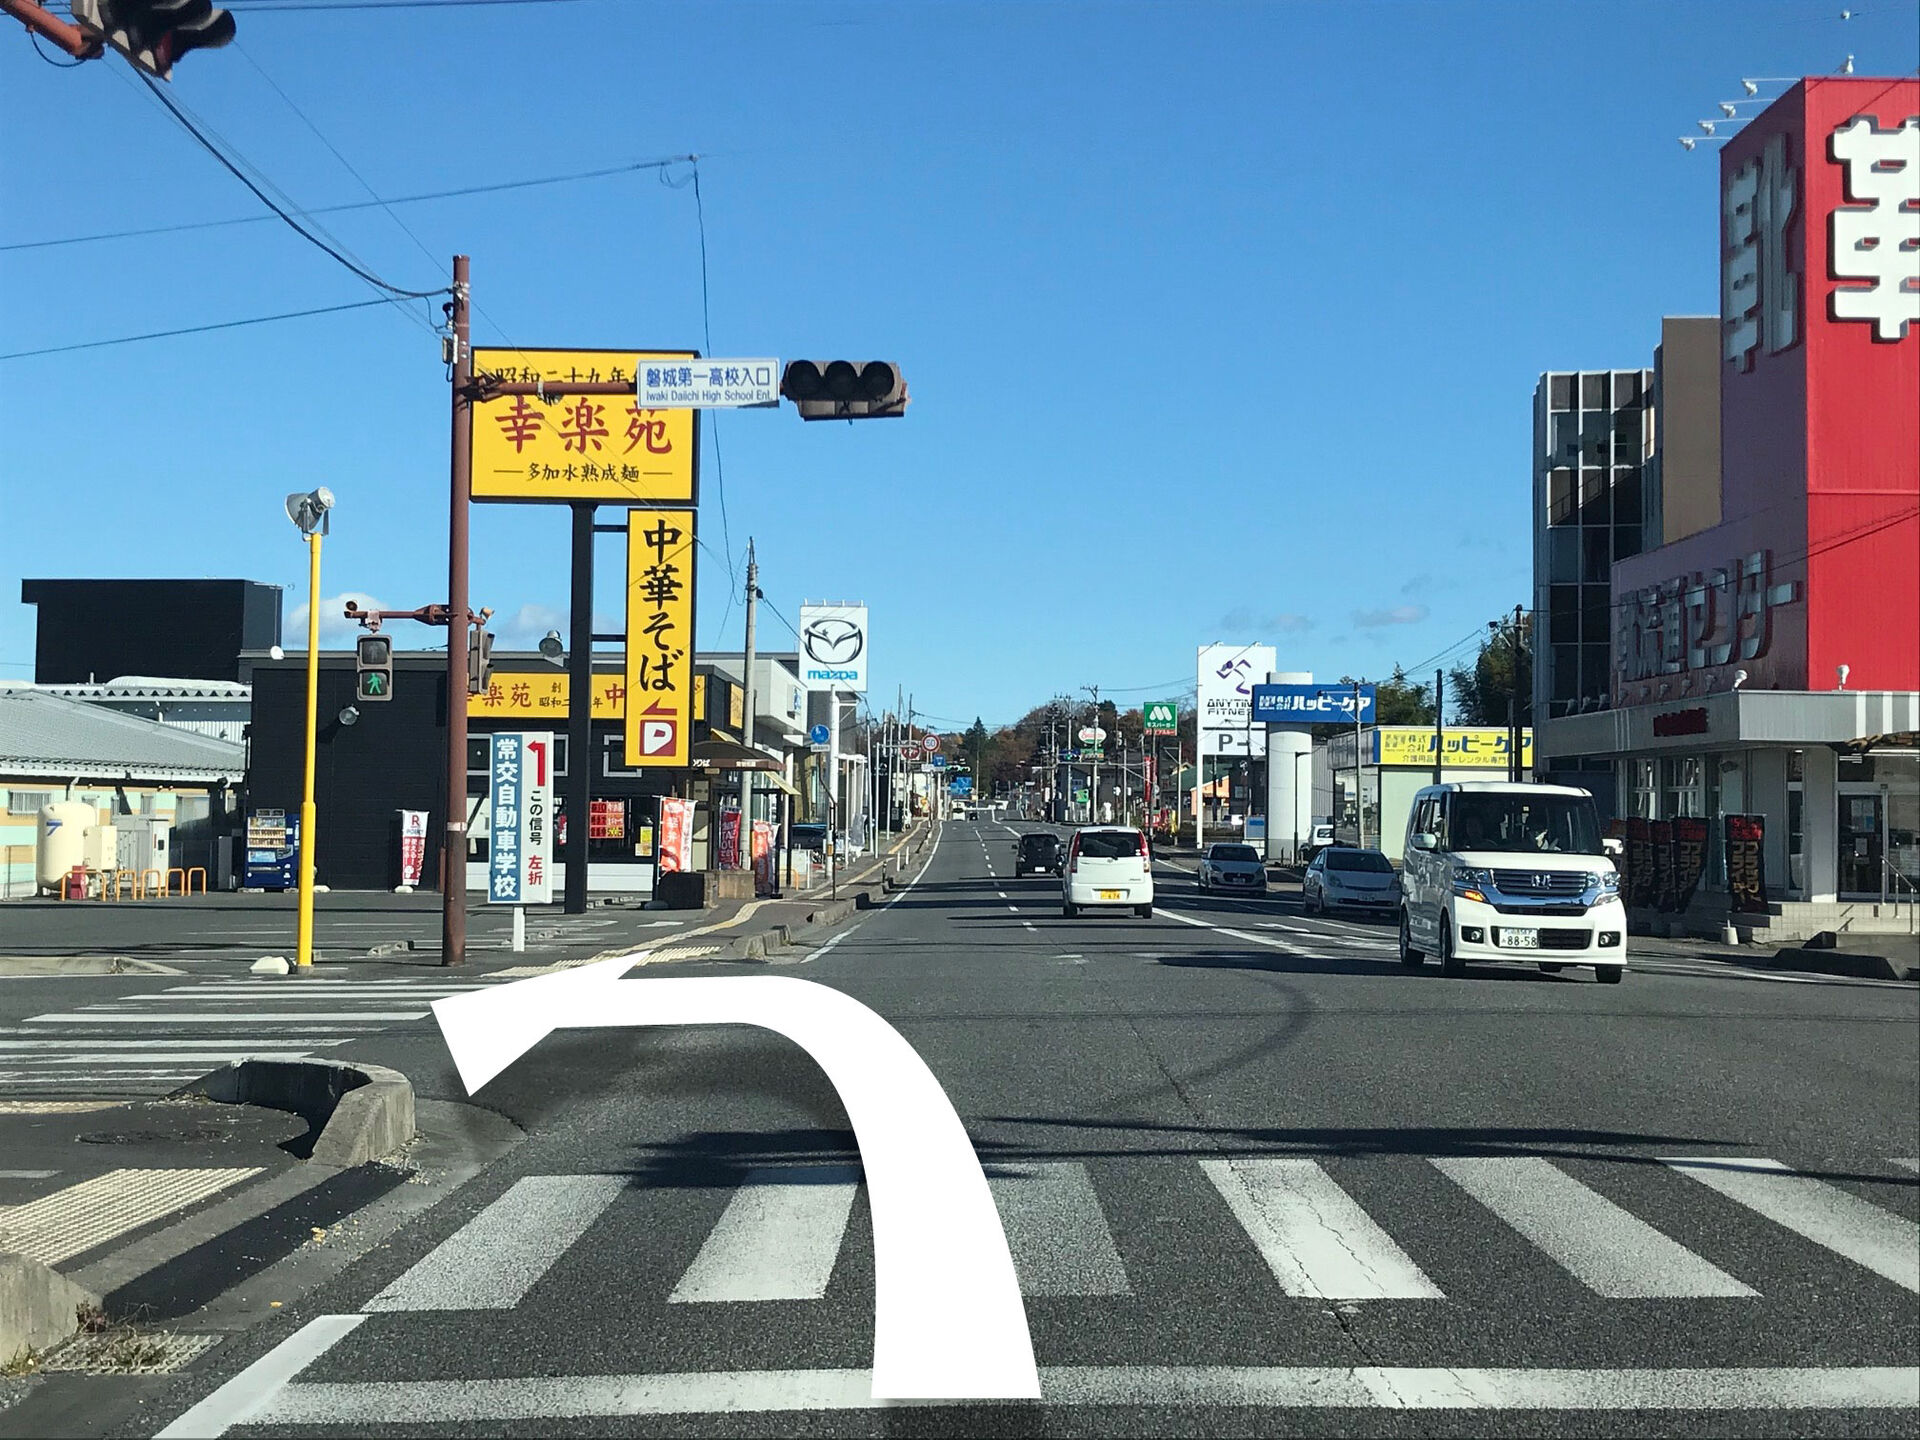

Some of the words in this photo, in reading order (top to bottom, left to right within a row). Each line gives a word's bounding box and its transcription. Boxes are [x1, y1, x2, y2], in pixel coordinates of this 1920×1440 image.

[646, 366, 771, 388] 磐城第一高校入口
[646, 389, 668, 401] Iwaki
[671, 389, 699, 401] Daiichi
[702, 390, 722, 403] High
[724, 391, 754, 402] School
[756, 391, 773, 402] Ent.
[494, 396, 673, 454] 幸楽苑
[526, 461, 640, 482] 多加水熟成麺
[638, 518, 685, 692] 中華そば
[467, 682, 532, 708] 楽苑
[494, 738, 518, 898] 常交自動車学校
[529, 790, 543, 846] この信号
[528, 855, 543, 886] 左折
[1507, 935, 1537, 947] 88-58
